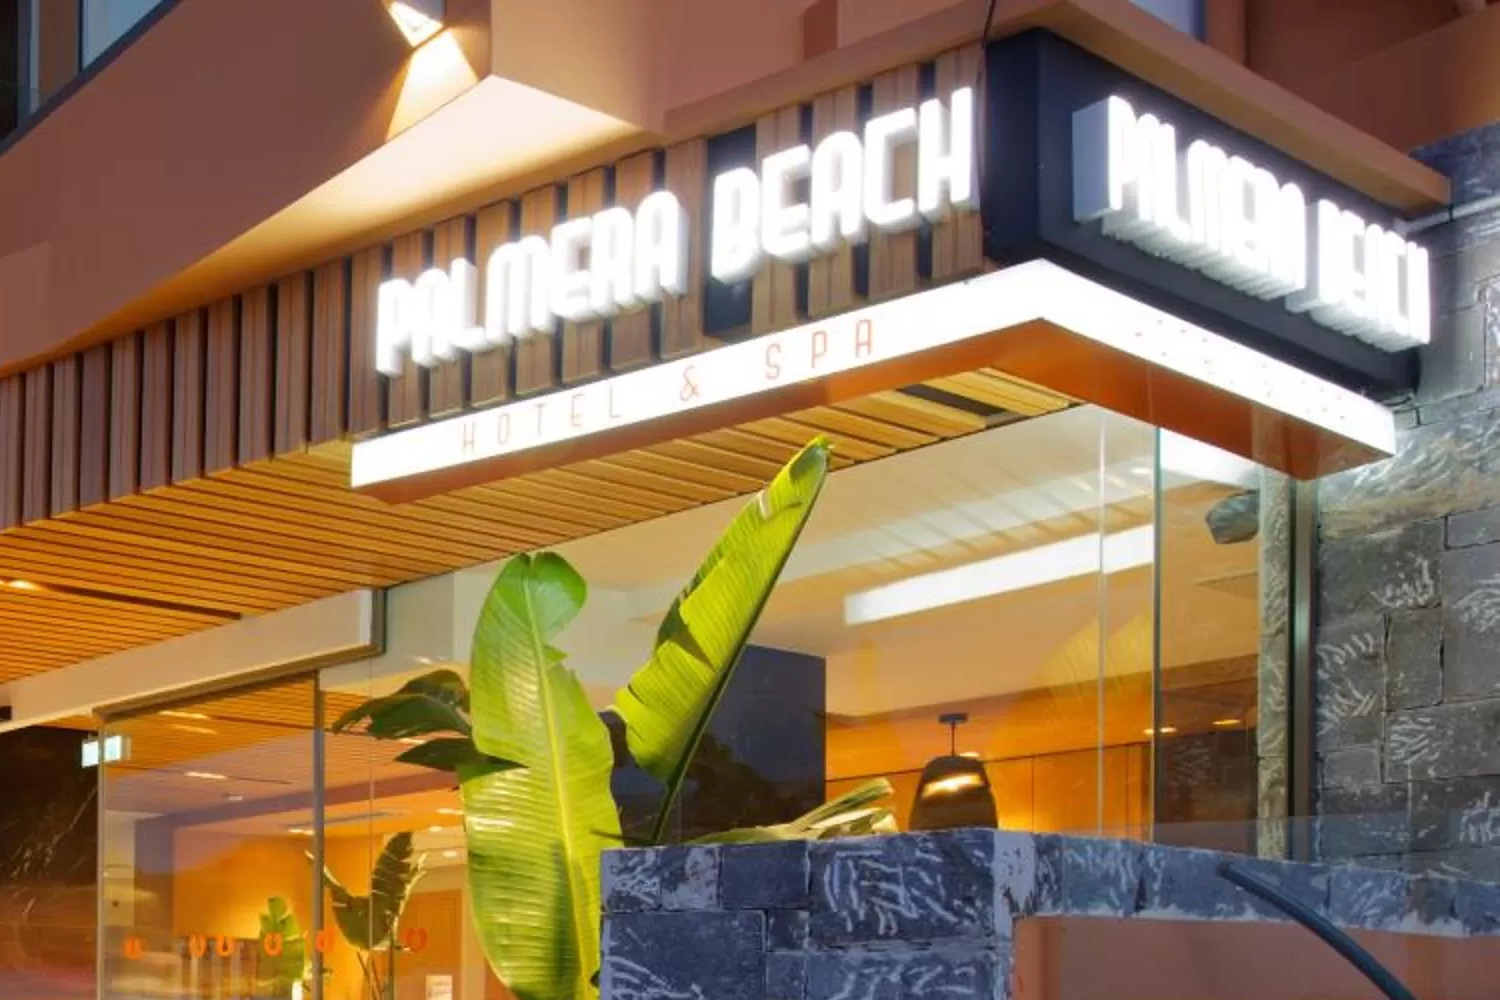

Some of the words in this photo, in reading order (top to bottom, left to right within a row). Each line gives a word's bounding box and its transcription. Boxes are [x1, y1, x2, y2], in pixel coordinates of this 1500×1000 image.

[376, 189, 689, 377] PALMERA
[710, 86, 976, 284] BEACH
[460, 385, 623, 454] HOTEL
[678, 364, 701, 401] &
[763, 318, 874, 381] SPA
